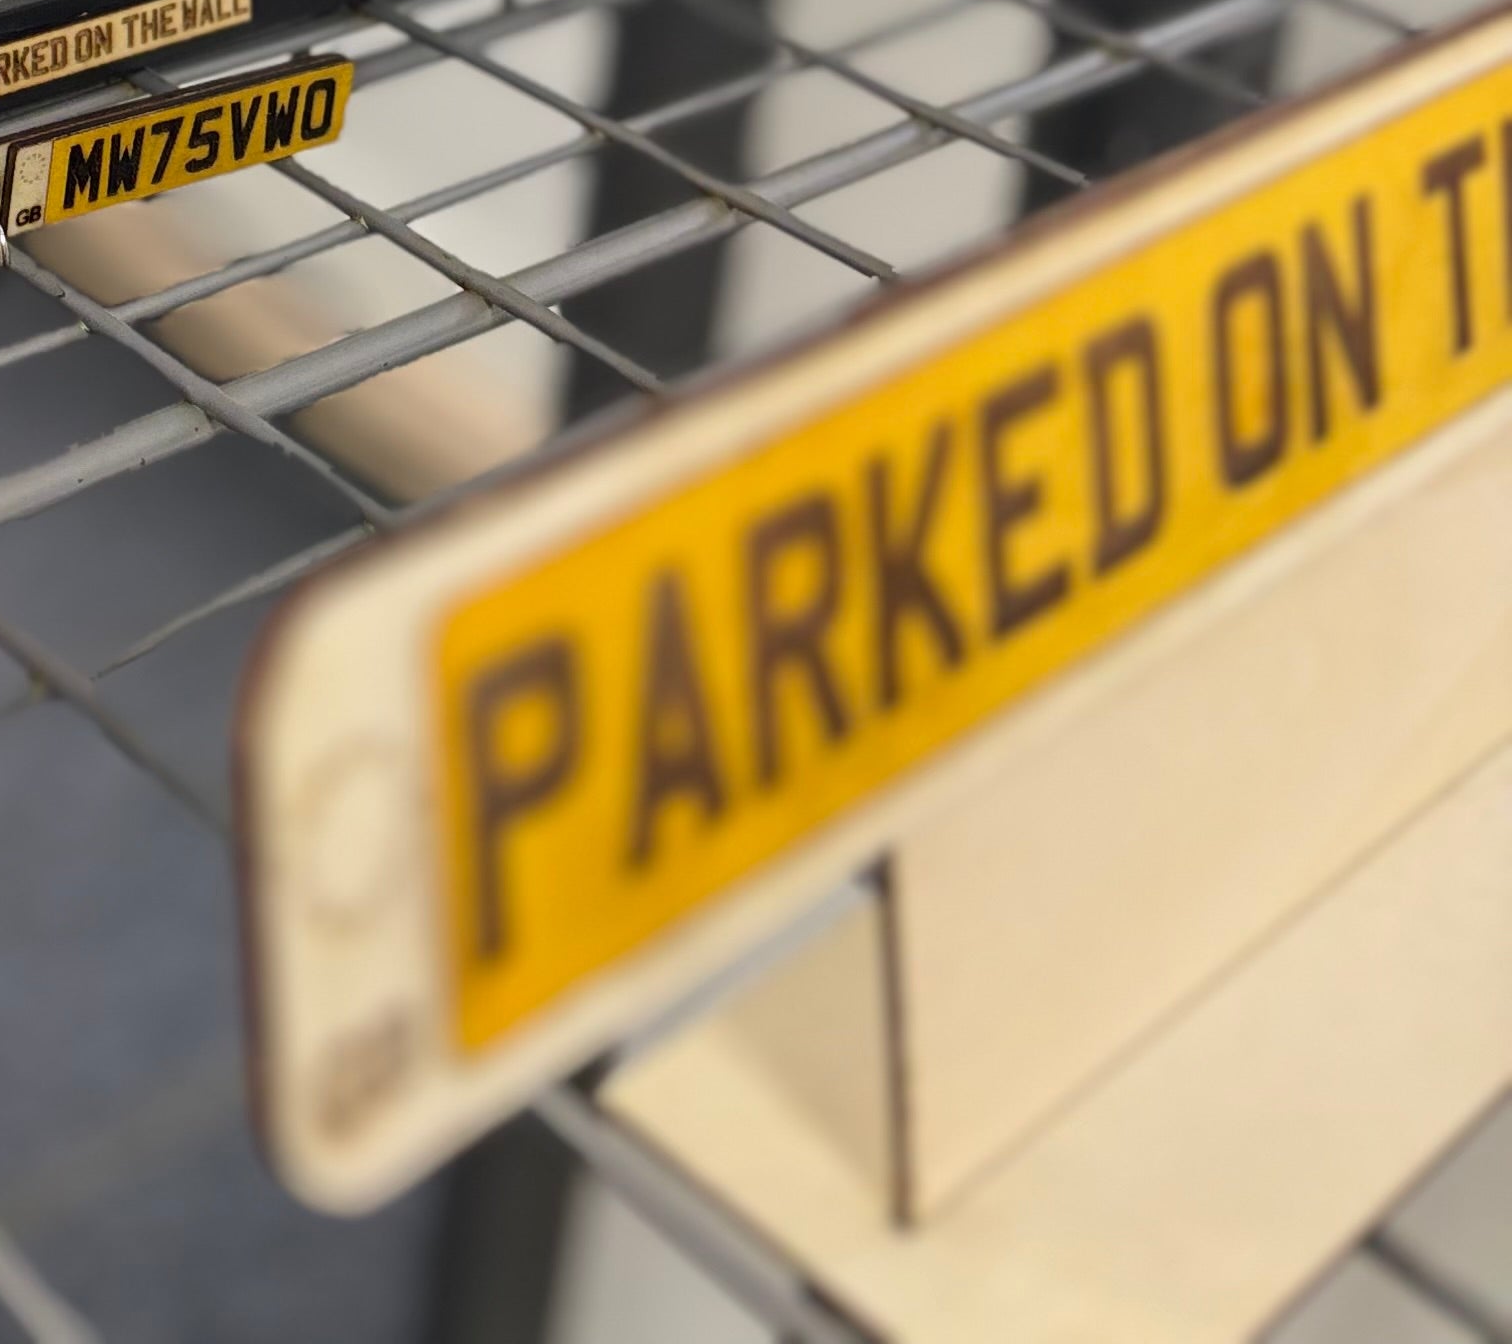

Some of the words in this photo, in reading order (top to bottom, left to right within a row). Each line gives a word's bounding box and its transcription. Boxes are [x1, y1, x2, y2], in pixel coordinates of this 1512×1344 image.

[74, 21, 113, 61] ON
[121, 2, 178, 49] THE
[15, 204, 43, 228] GB
[460, 310, 1173, 972] PARKED
[1208, 188, 1382, 494] ON
